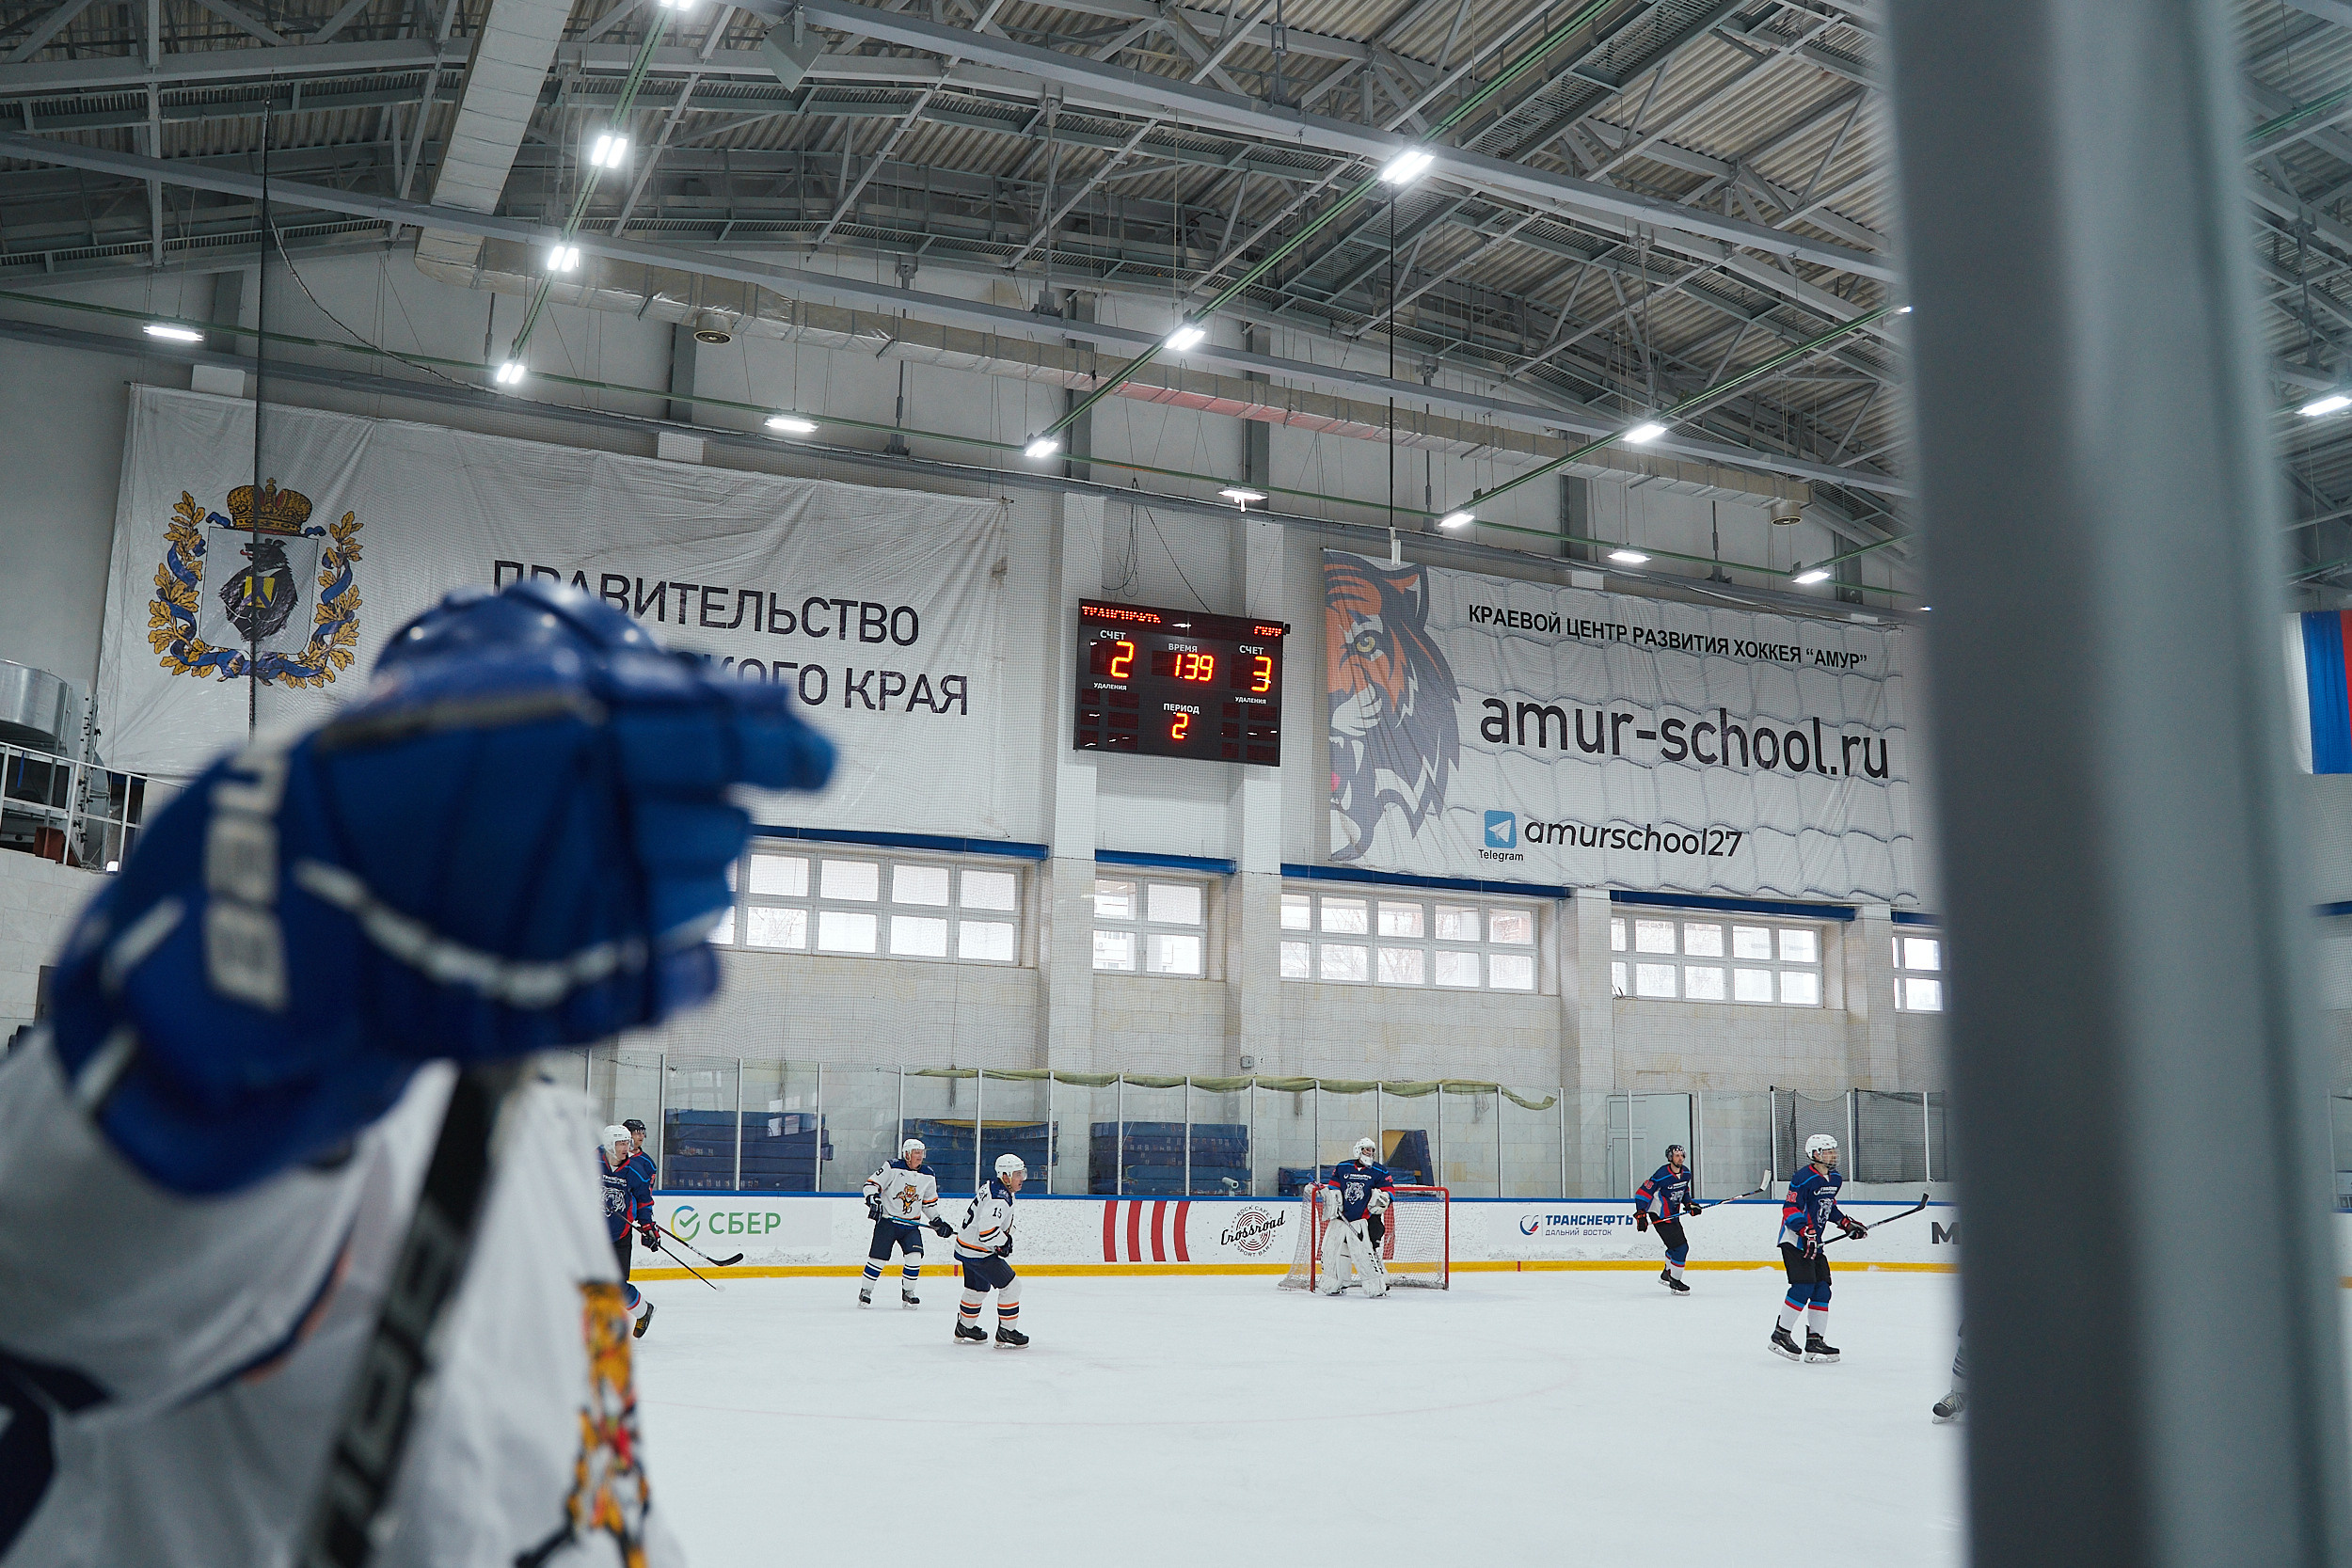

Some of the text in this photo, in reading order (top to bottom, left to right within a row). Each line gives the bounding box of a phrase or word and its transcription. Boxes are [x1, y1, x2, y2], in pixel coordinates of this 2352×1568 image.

[1100, 629, 1127, 641] СЧЕТ
[1469, 604, 1561, 634] КРАЕВОЙ
[1566, 618, 1628, 641] ЦЕНТР
[1632, 626, 1729, 656] РАЗВИТИЯ
[1733, 639, 1803, 663] ХОККЕЯ
[1168, 642, 1199, 654] ВРЕМЯ
[1238, 644, 1264, 656] СЧЕТ
[1110, 641, 1135, 678] 2
[1250, 656, 1272, 692] 3
[844, 667, 968, 716] КРАЯ
[1093, 682, 1128, 691] УДАЛЕНИЯ
[1163, 703, 1200, 715] ПЕРИОД
[1234, 696, 1267, 705] УДАЛЕНИЯ
[1171, 712, 1189, 739] 2
[1480, 697, 1889, 779] amur-school.ru
[1524, 821, 1743, 857] amurschool27
[1478, 848, 1524, 862] Telegram
[708, 1212, 782, 1235] СБЕР
[1220, 1210, 1286, 1246] Crossroad
[1545, 1214, 1634, 1226] ТРАНСНЕФТЬ
[1545, 1227, 1580, 1236] ДАЛЬНИЙ
